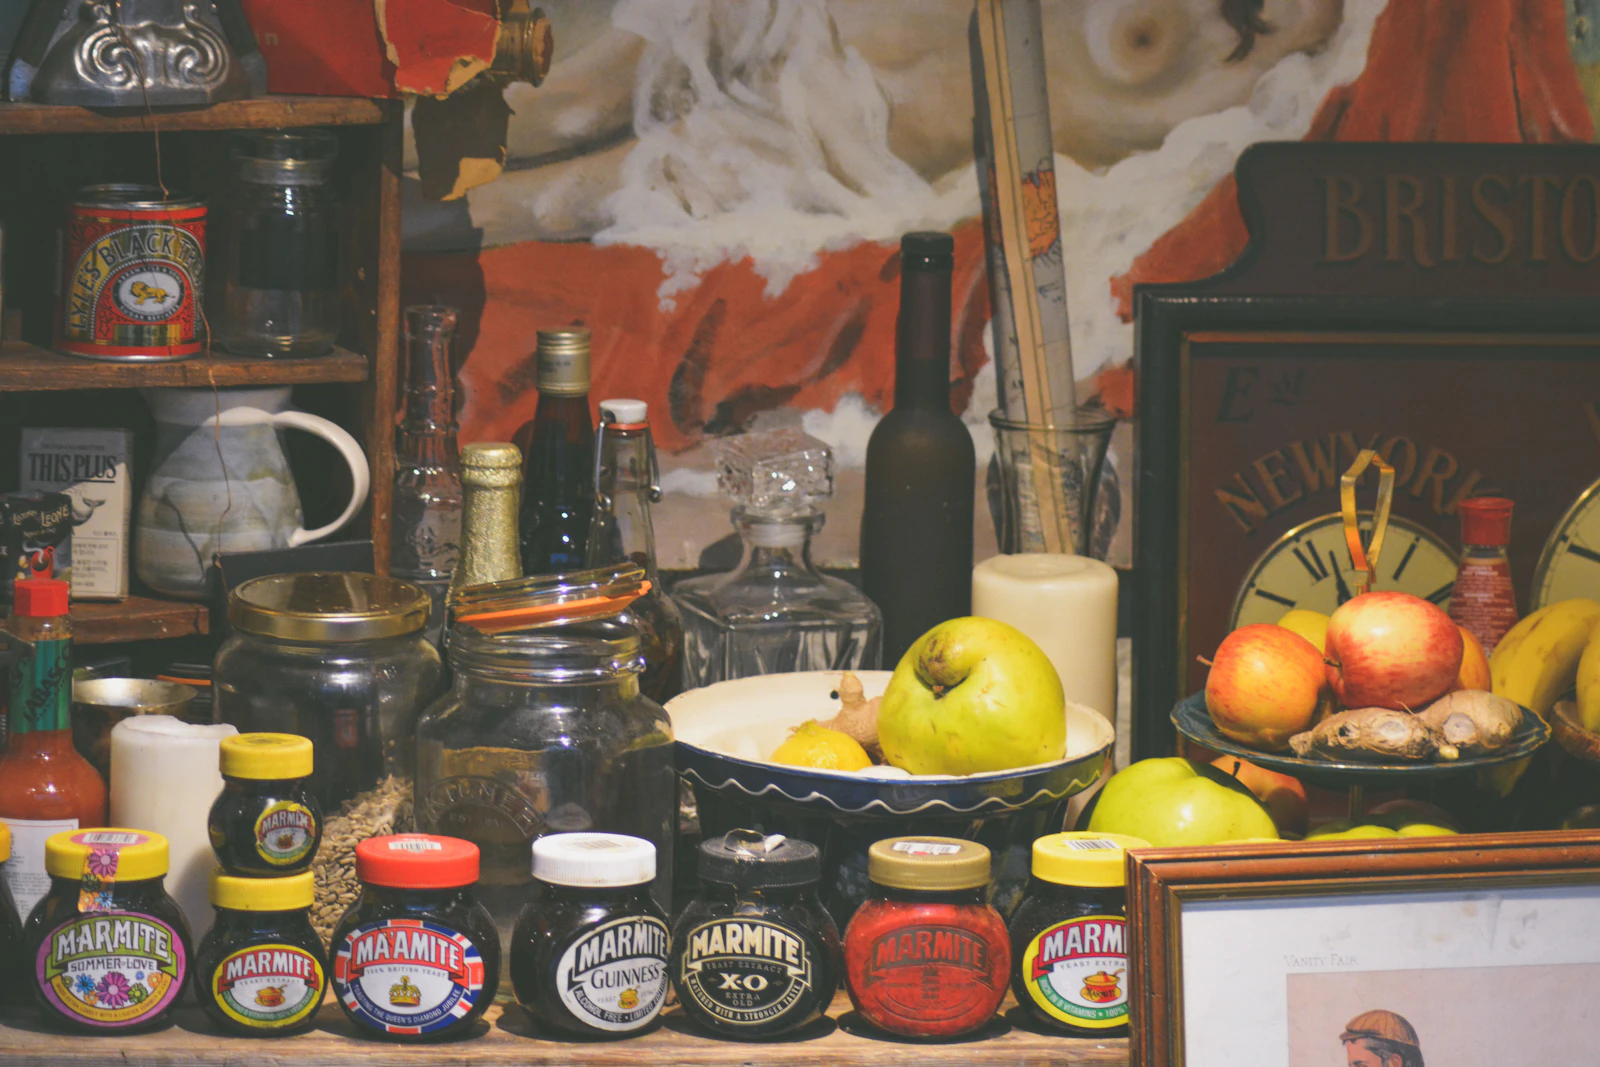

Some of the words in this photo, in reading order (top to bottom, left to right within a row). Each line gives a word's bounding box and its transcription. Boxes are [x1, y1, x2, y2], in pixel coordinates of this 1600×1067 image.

[71, 261, 101, 331] LYLE'S
[98, 231, 177, 268] BLACK
[73, 454, 117, 480] PLUS
[56, 919, 169, 961] MARMITE
[356, 930, 459, 970] MA'AMITE
[579, 923, 668, 972] MARMITE
[692, 923, 799, 965] MARMITE
[875, 930, 983, 968] MARMITE
[70, 958, 121, 972] SUMMER
[127, 958, 154, 971] LOVE
[226, 951, 312, 980] MARMITE
[422, 968, 446, 978] YEAST
[705, 961, 734, 970] YEAST
[739, 961, 783, 974] EXTRACT
[1060, 960, 1091, 970] YEAST
[1283, 954, 1325, 967] VANITY
[1330, 953, 1359, 966] FAIR
[239, 978, 263, 986] YEAST
[591, 962, 660, 989] GUINNESS
[354, 983, 373, 1013] TOASTING
[374, 1007, 385, 1019] THE
[385, 1013, 413, 1024] QUEEN'S
[413, 1007, 442, 1023] DIAMOND
[441, 989, 461, 1012] JUBILEE
[575, 989, 602, 1018] ALCOHOL
[603, 1011, 622, 1022] FREE
[630, 1001, 655, 1020] LIMITED
[690, 978, 713, 1009] MATURED
[715, 1007, 734, 1019] WITH
[736, 1012, 742, 1020] A
[744, 1004, 783, 1021] STRONGER
[783, 984, 801, 1006] TASTE
[725, 992, 760, 1000] EXTRA
[1063, 1003, 1097, 1019] VITAMINS
[1105, 1007, 1125, 1018] 100%
